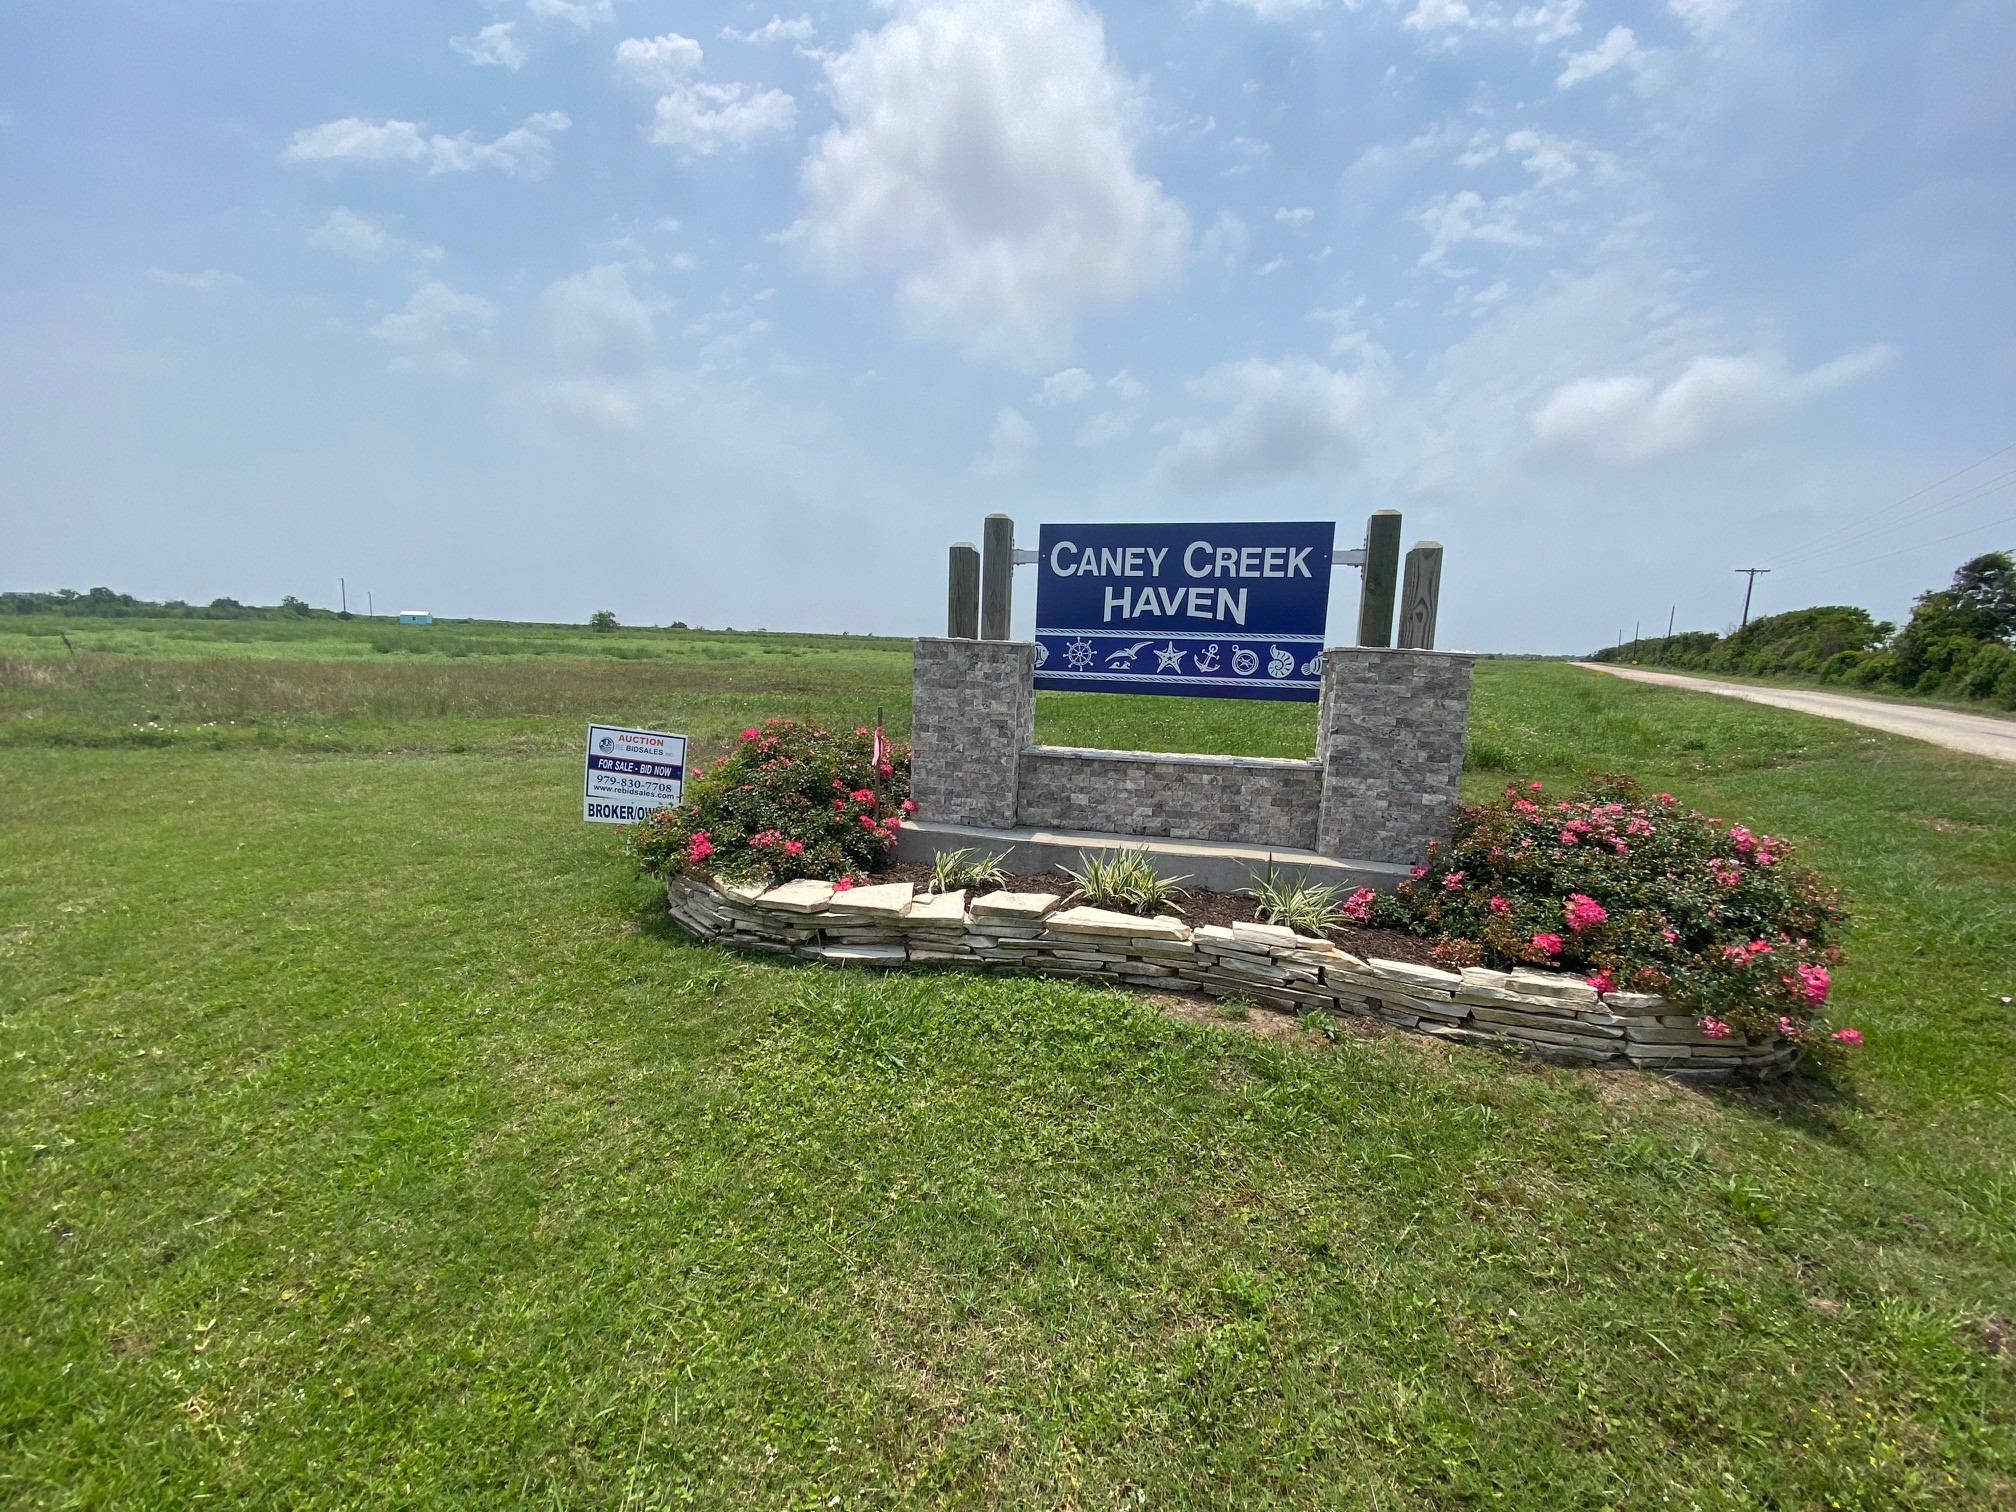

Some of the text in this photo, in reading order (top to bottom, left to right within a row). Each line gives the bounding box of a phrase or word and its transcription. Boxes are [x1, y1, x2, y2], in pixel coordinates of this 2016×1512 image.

[1050, 540, 1313, 578] CANEY CREEK
[1103, 586, 1248, 625] HAVEN
[619, 735, 664, 746] AUCTION
[626, 746, 664, 755] BIDSALES
[598, 759, 613, 769] FOR
[615, 761, 633, 772] SALE
[640, 765, 652, 774] BID
[653, 766, 671, 776] NOW
[594, 785, 674, 799] www.rebidsales.com
[597, 775, 672, 792] 979-830-7708
